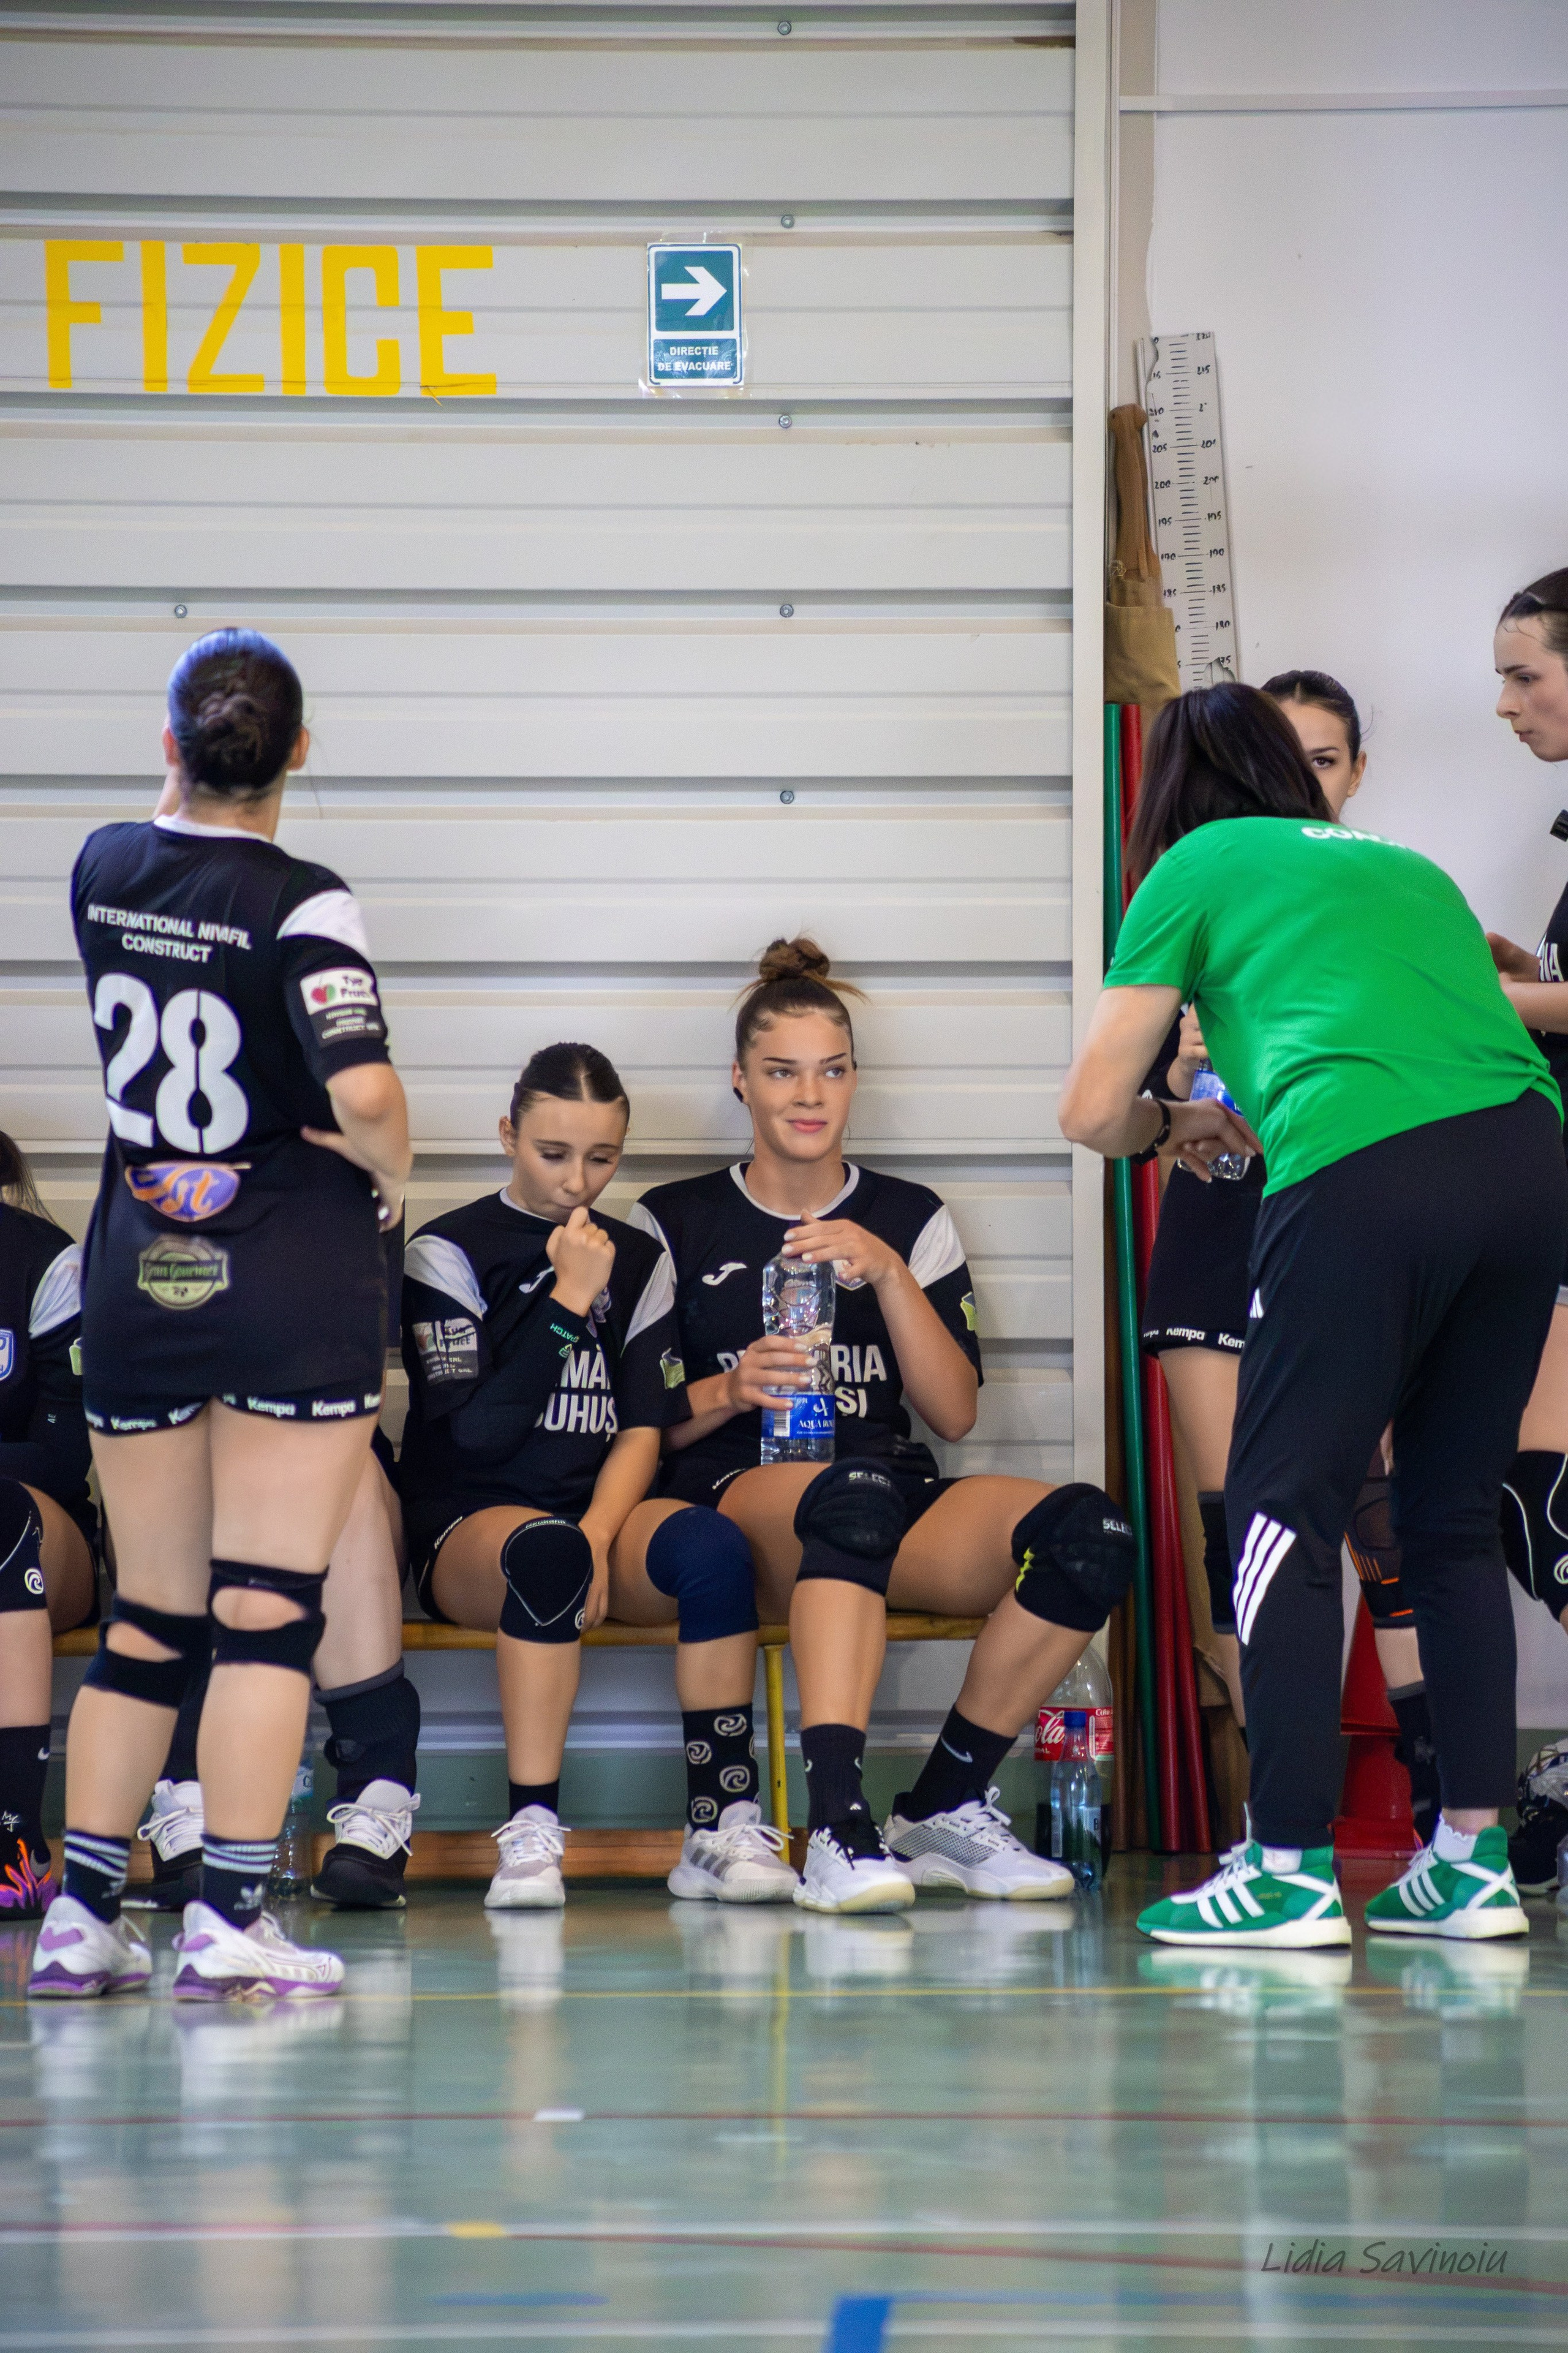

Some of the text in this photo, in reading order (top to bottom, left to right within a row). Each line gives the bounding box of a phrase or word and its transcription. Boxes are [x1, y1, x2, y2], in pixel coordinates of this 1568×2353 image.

[45, 240, 497, 396] FIZICE
[658, 361, 731, 371] DE EVACUARE
[1152, 443, 1167, 453] 205
[88, 903, 252, 951] INTERNATIONAL NIVAFIL
[121, 932, 214, 964] CONSTRUCT
[94, 972, 250, 1154] 28
[247, 1396, 296, 1418] Kempa
[312, 1399, 356, 1417] Kempa
[535, 1392, 618, 1443] UHUȘ
[799, 1419, 821, 1430] AQUA
